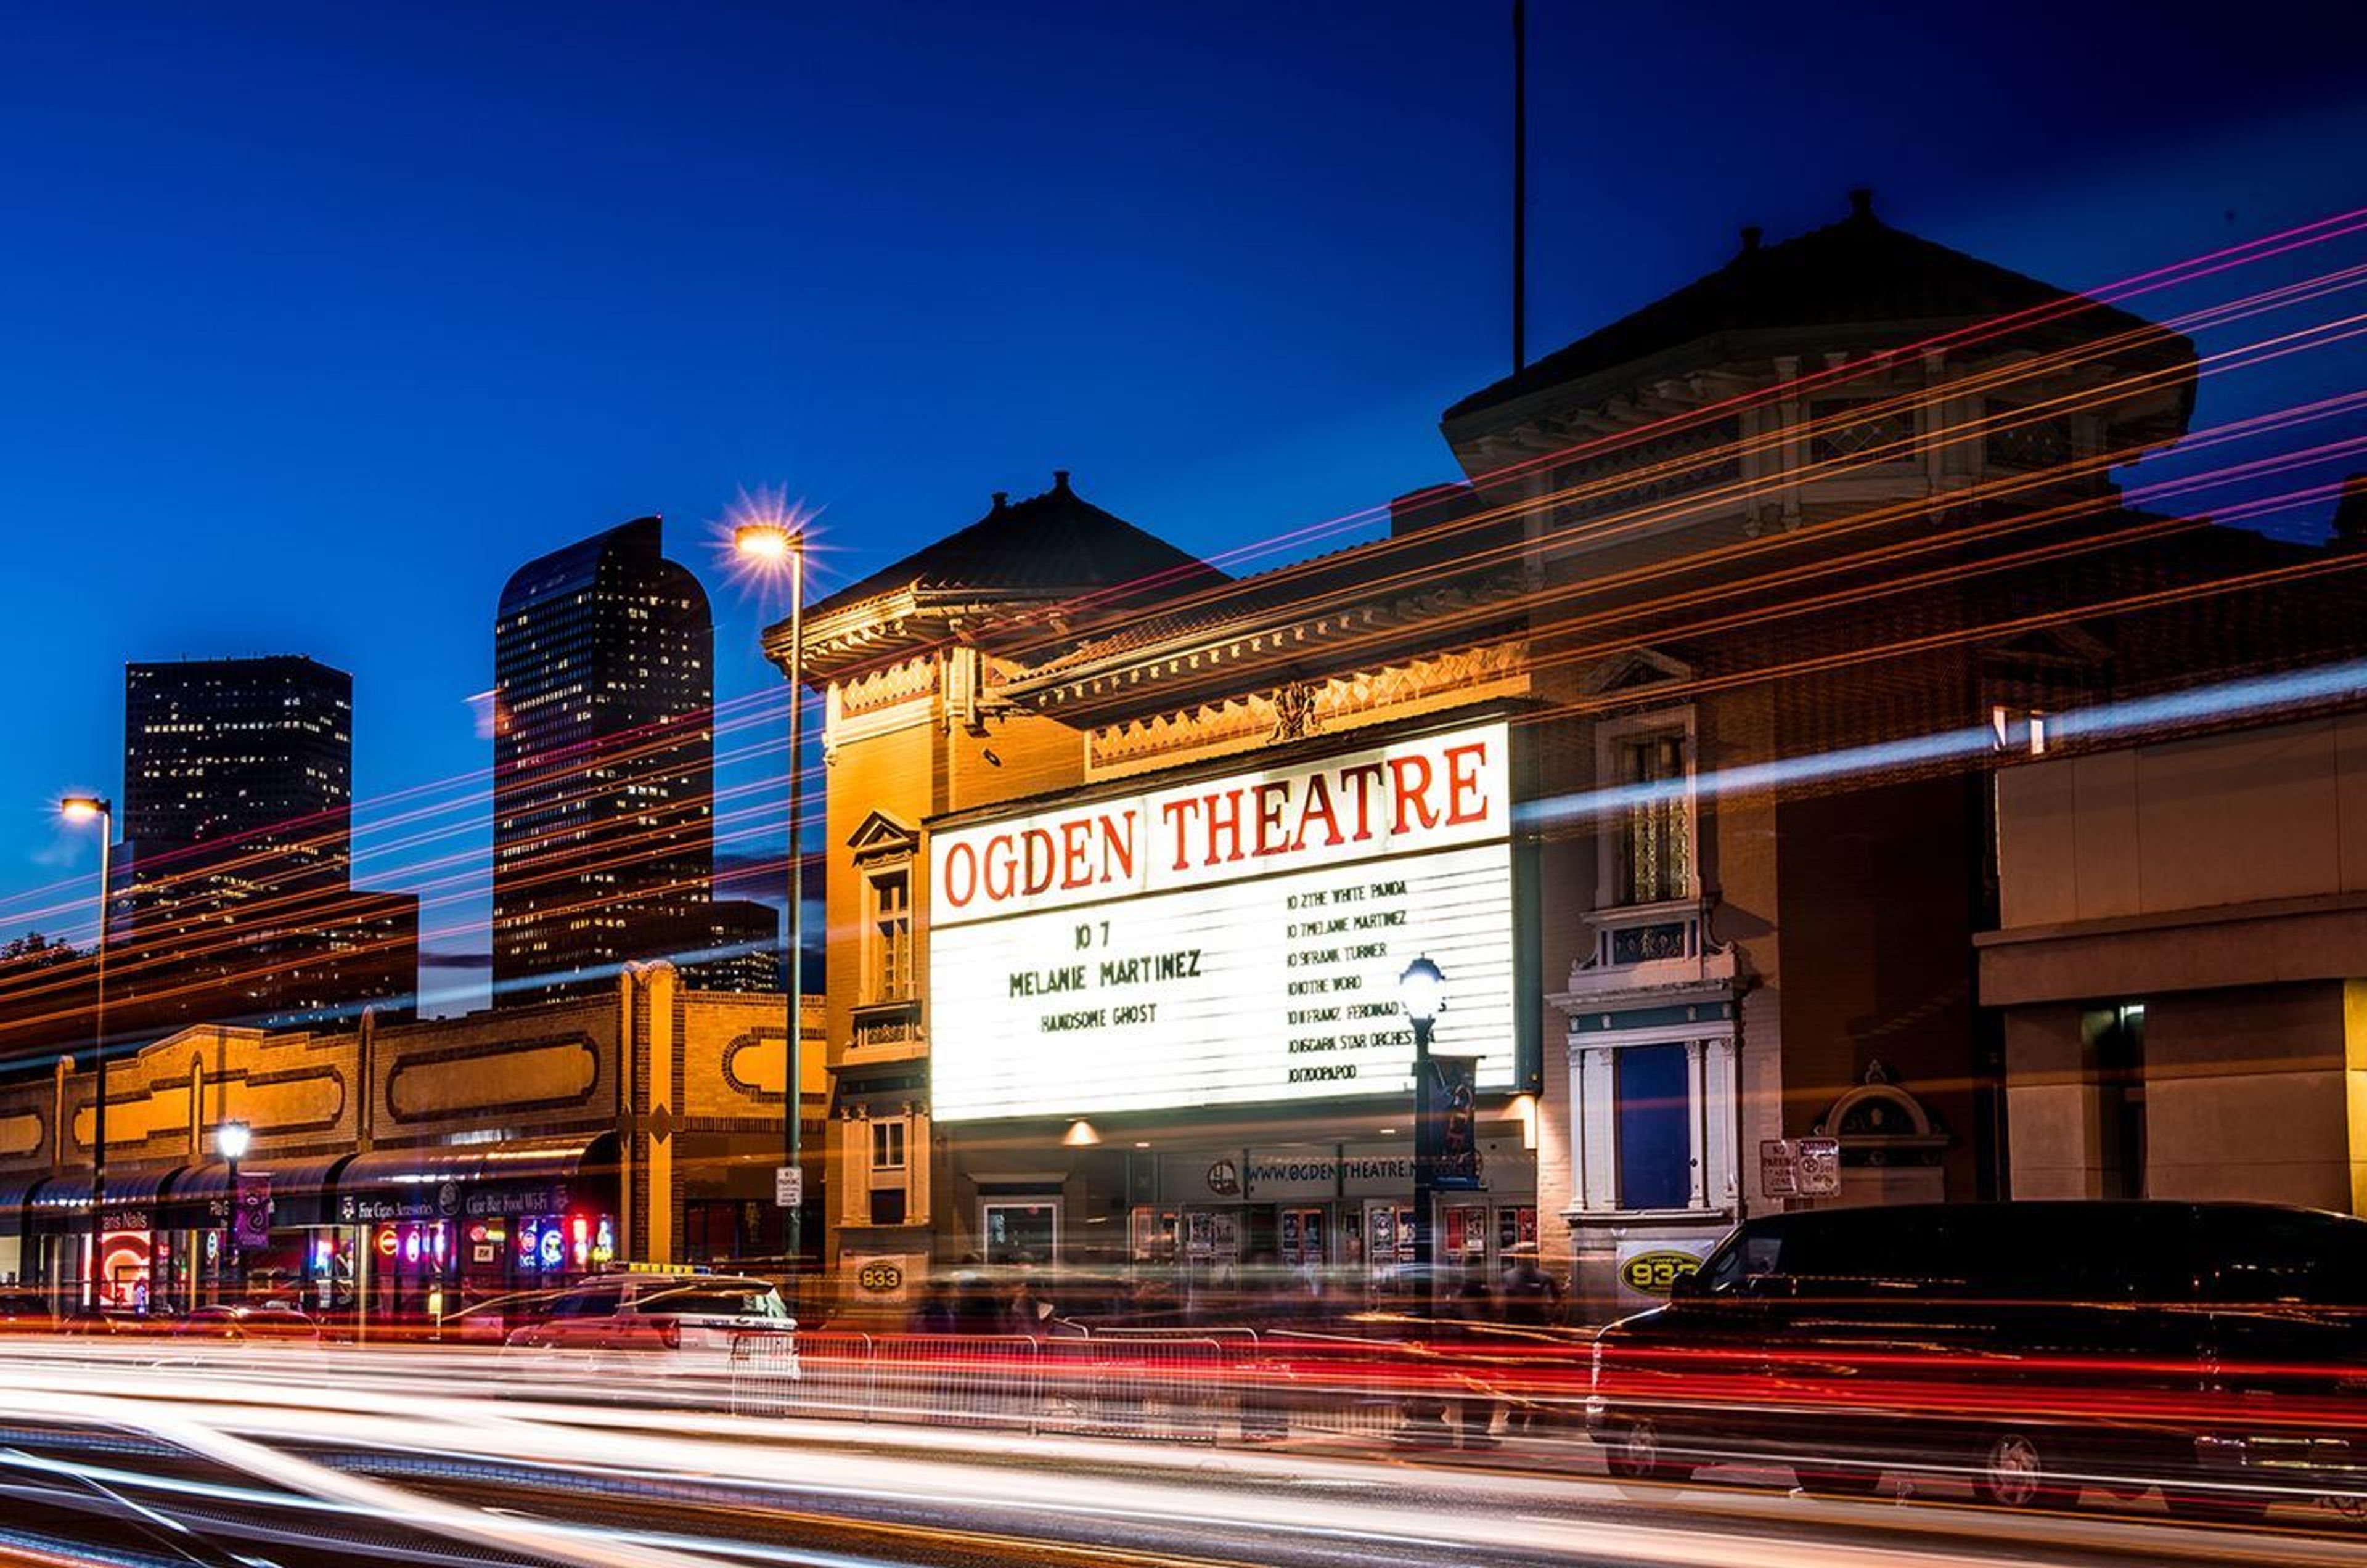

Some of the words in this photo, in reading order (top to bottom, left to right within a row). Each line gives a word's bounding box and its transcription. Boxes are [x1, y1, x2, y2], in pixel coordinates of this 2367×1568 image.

[944, 809, 1137, 908] OGDEN
[1163, 741, 1489, 870] THEATRE
[1331, 886, 1366, 904] WHITE
[1370, 880, 1407, 899] PANDA
[1353, 910, 1406, 931] MARTINEZ
[1344, 942, 1386, 961] TURNER
[1009, 965, 1087, 998] MELANIE
[1100, 948, 1202, 987] MARTINEZ
[1332, 974, 1362, 991] WORD
[1041, 1009, 1107, 1033] HANDSOME
[1112, 1003, 1157, 1026] GHOST
[1339, 1034, 1367, 1050] STAR
